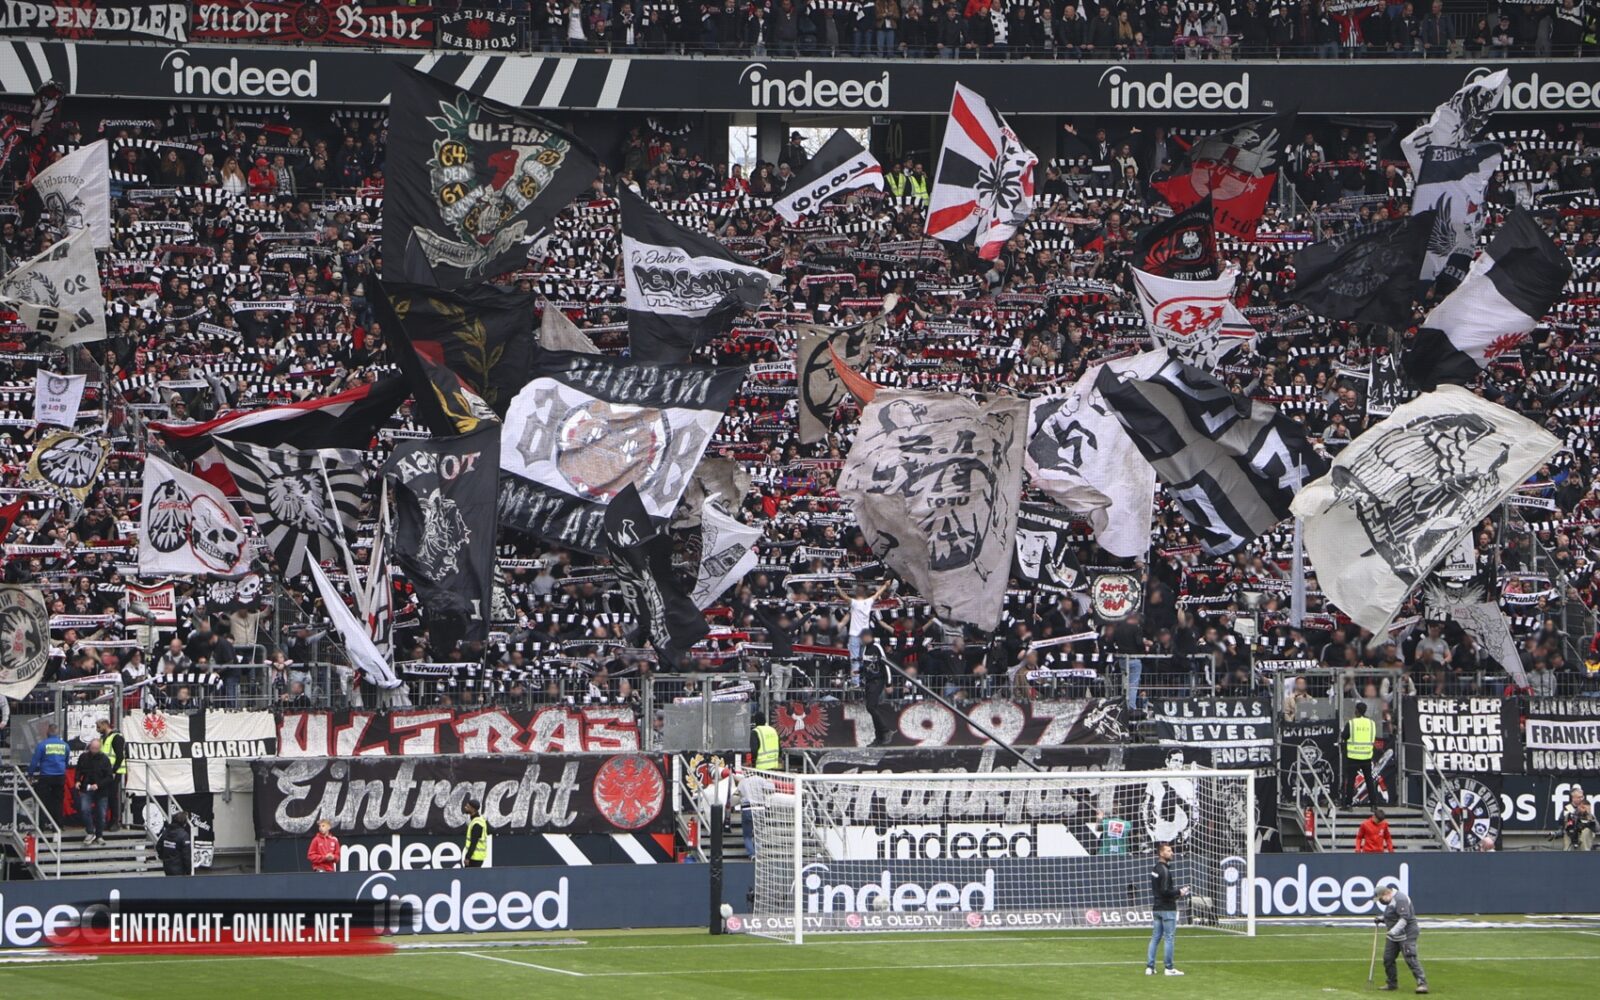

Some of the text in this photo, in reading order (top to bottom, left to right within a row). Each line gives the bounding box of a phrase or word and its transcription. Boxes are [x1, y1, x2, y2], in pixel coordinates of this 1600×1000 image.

[198, 4, 424, 40] Nieder Bube
[441, 31, 517, 49] WARRIORS
[172, 55, 318, 98] indeed
[748, 66, 889, 108] indeed
[1109, 70, 1250, 110] indeed
[467, 122, 553, 144] ULTRAS
[441, 143, 466, 166] 64
[537, 150, 561, 165] 65
[443, 167, 470, 182] DEM
[442, 182, 466, 204] 61
[519, 175, 535, 198] 36
[791, 161, 868, 212] 1899
[644, 250, 686, 264] Jahre
[1173, 271, 1194, 280] SEIT
[242, 301, 287, 310] Eintracht
[754, 362, 792, 372] Eintracht
[805, 549, 844, 558] Eintracht
[1181, 594, 1231, 604] Eintracht
[1163, 700, 1262, 718] ULTRAS
[1417, 698, 1502, 713] EHRE DER
[278, 706, 641, 759] ULTRAS
[842, 700, 1088, 748] 1997
[1173, 723, 1258, 741] NEVER
[1419, 714, 1502, 735] GRUPPE
[128, 739, 267, 760] NUOVA GUARDIA
[1421, 735, 1503, 752] STADION
[1425, 752, 1503, 772] VERBOT
[271, 758, 580, 834] Eintracht
[876, 822, 1037, 859] indeed
[340, 834, 493, 871] ndeed
[801, 867, 995, 913] indeed
[1221, 860, 1410, 916] indeed
[362, 874, 570, 933] indeed
[743, 916, 823, 929] LG OLE TV
[863, 914, 943, 926] LG OLED TV
[983, 912, 1062, 925] LG OLED TV
[1103, 911, 1154, 922] LG OLE
